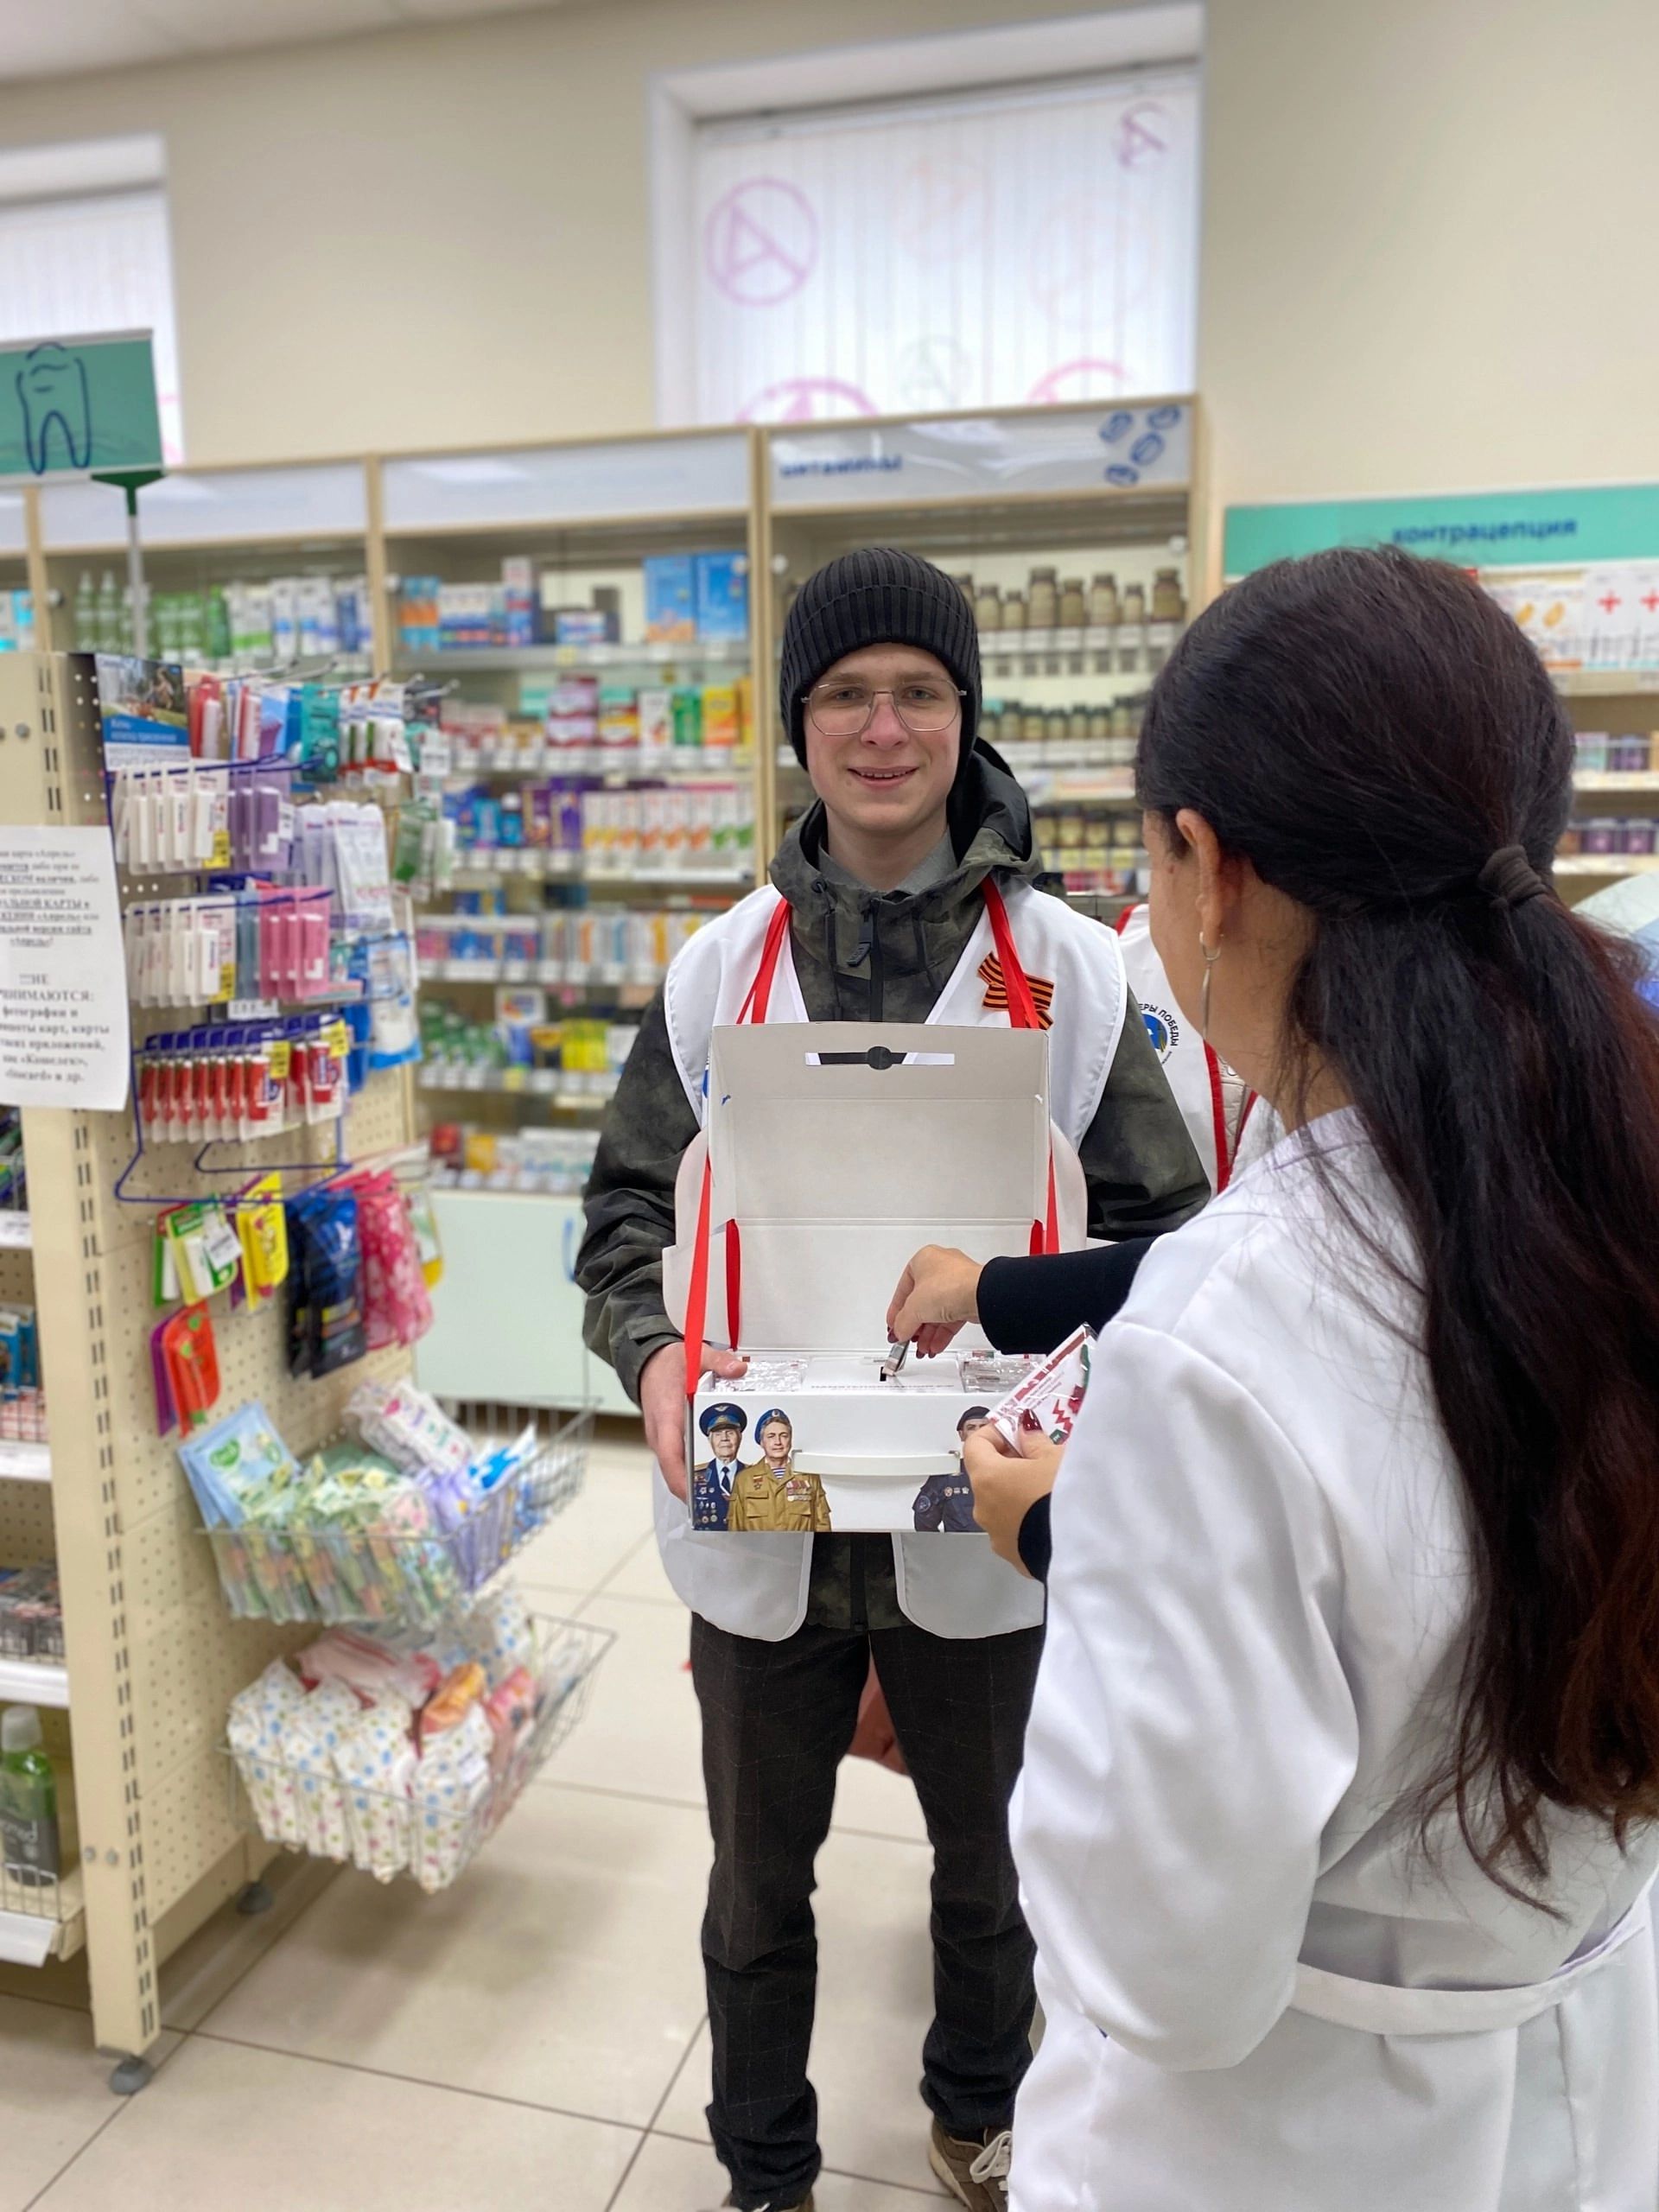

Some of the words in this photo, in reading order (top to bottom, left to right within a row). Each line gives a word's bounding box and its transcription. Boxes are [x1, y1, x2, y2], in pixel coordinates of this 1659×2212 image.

[1393, 518, 1579, 546] контрацепция
[0, 989, 94, 1002] ИНИМАЮТСЯ:
[3, 1006, 67, 1020] фотографии
[1158, 1009, 1179, 1046] ПОБЕДЫ
